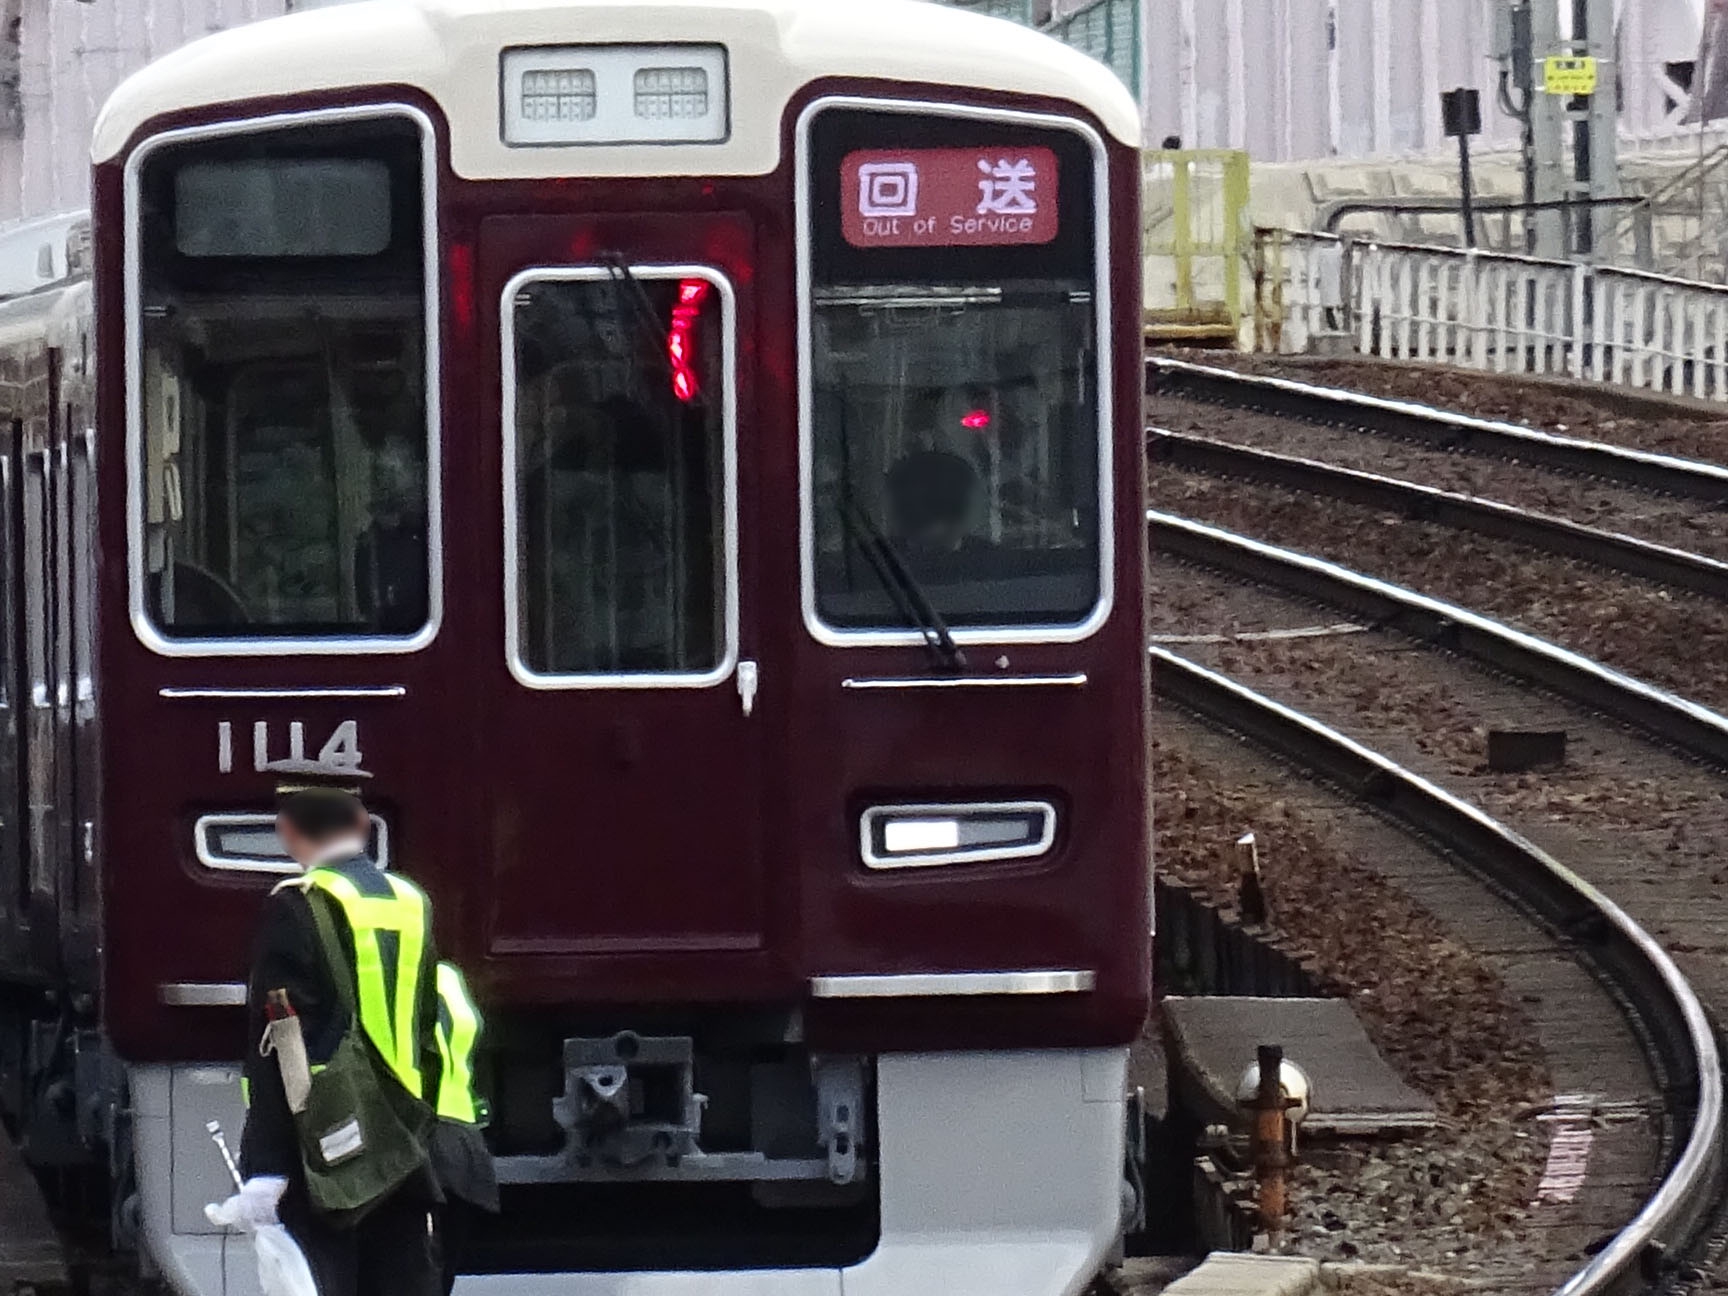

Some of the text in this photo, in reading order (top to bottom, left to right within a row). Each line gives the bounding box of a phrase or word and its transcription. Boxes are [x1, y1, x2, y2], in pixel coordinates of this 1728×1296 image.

[858, 158, 1038, 217] 回送
[862, 215, 1034, 236] Out of Service
[218, 720, 363, 773] 1114
